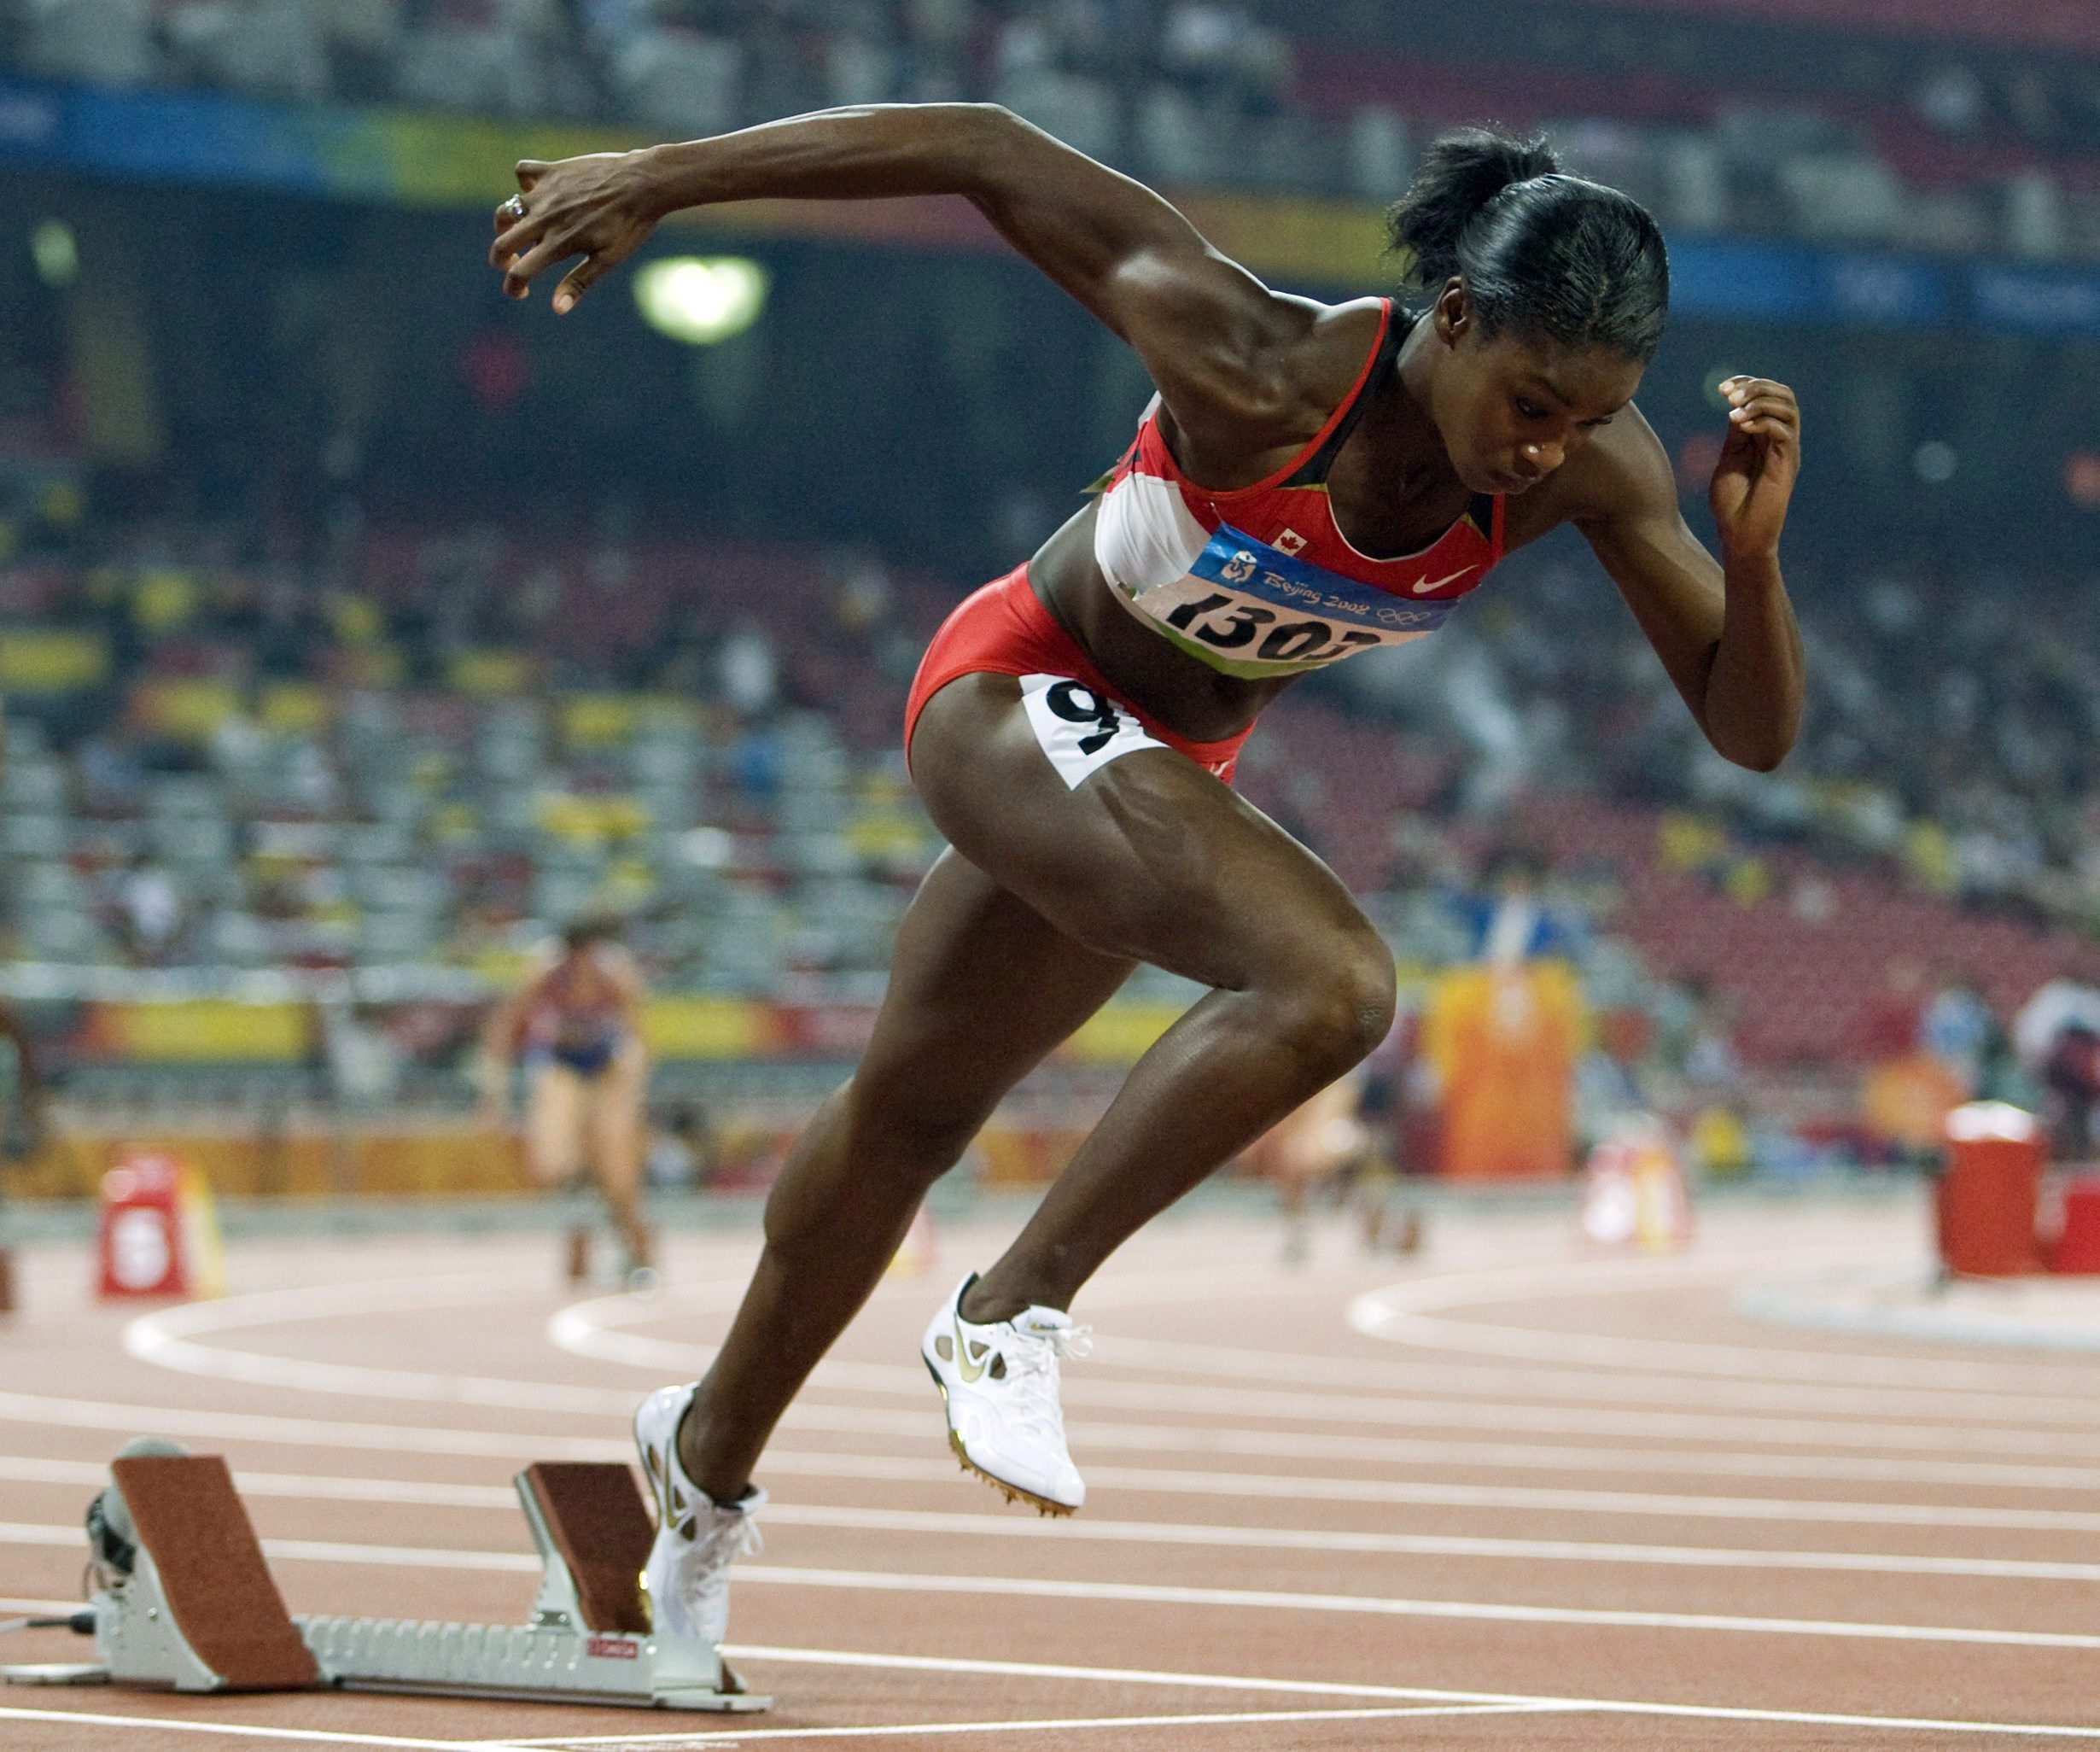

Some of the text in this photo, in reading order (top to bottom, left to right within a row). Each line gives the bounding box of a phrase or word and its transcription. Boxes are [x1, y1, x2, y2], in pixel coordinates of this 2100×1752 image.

[1263, 570, 1370, 616] Beijing 2008
[1046, 680, 1120, 756] 9
